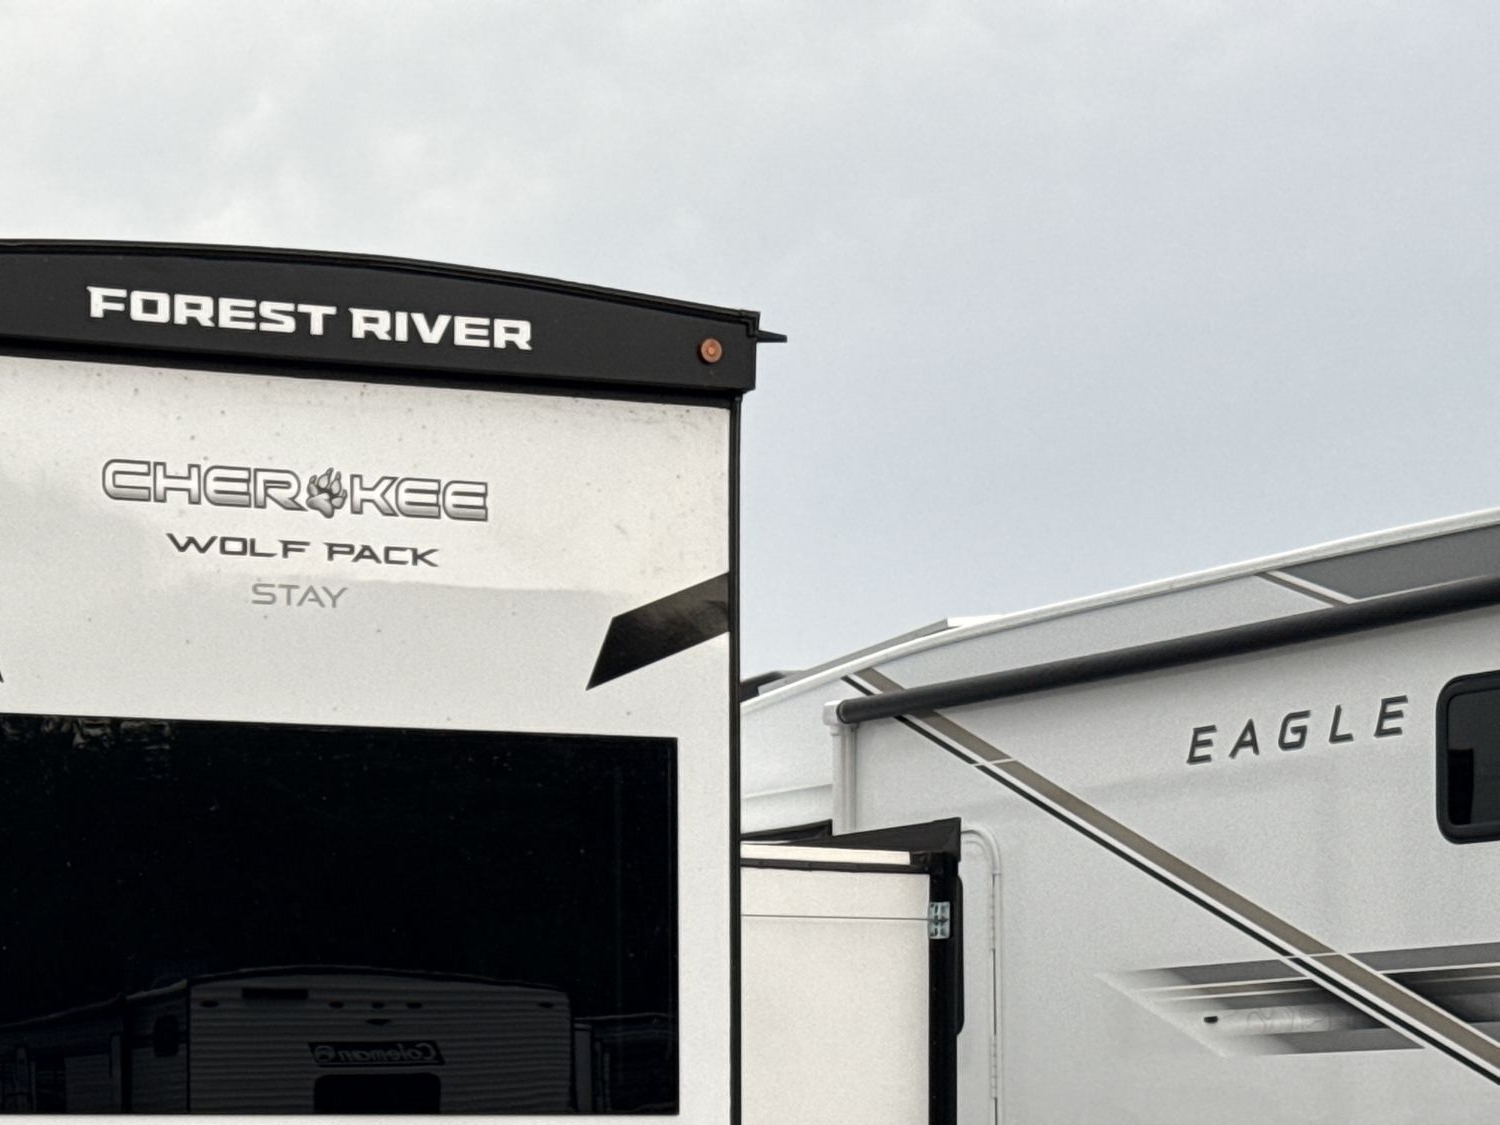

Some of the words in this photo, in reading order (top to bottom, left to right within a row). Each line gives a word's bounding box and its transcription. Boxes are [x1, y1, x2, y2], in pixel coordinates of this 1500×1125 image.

[86, 286, 337, 336] FOREST
[348, 307, 533, 351] RIVER
[165, 533, 311, 559] WOLF
[323, 542, 439, 568] PACK
[251, 583, 348, 608] STAY
[1186, 695, 1409, 764] EAGLE
